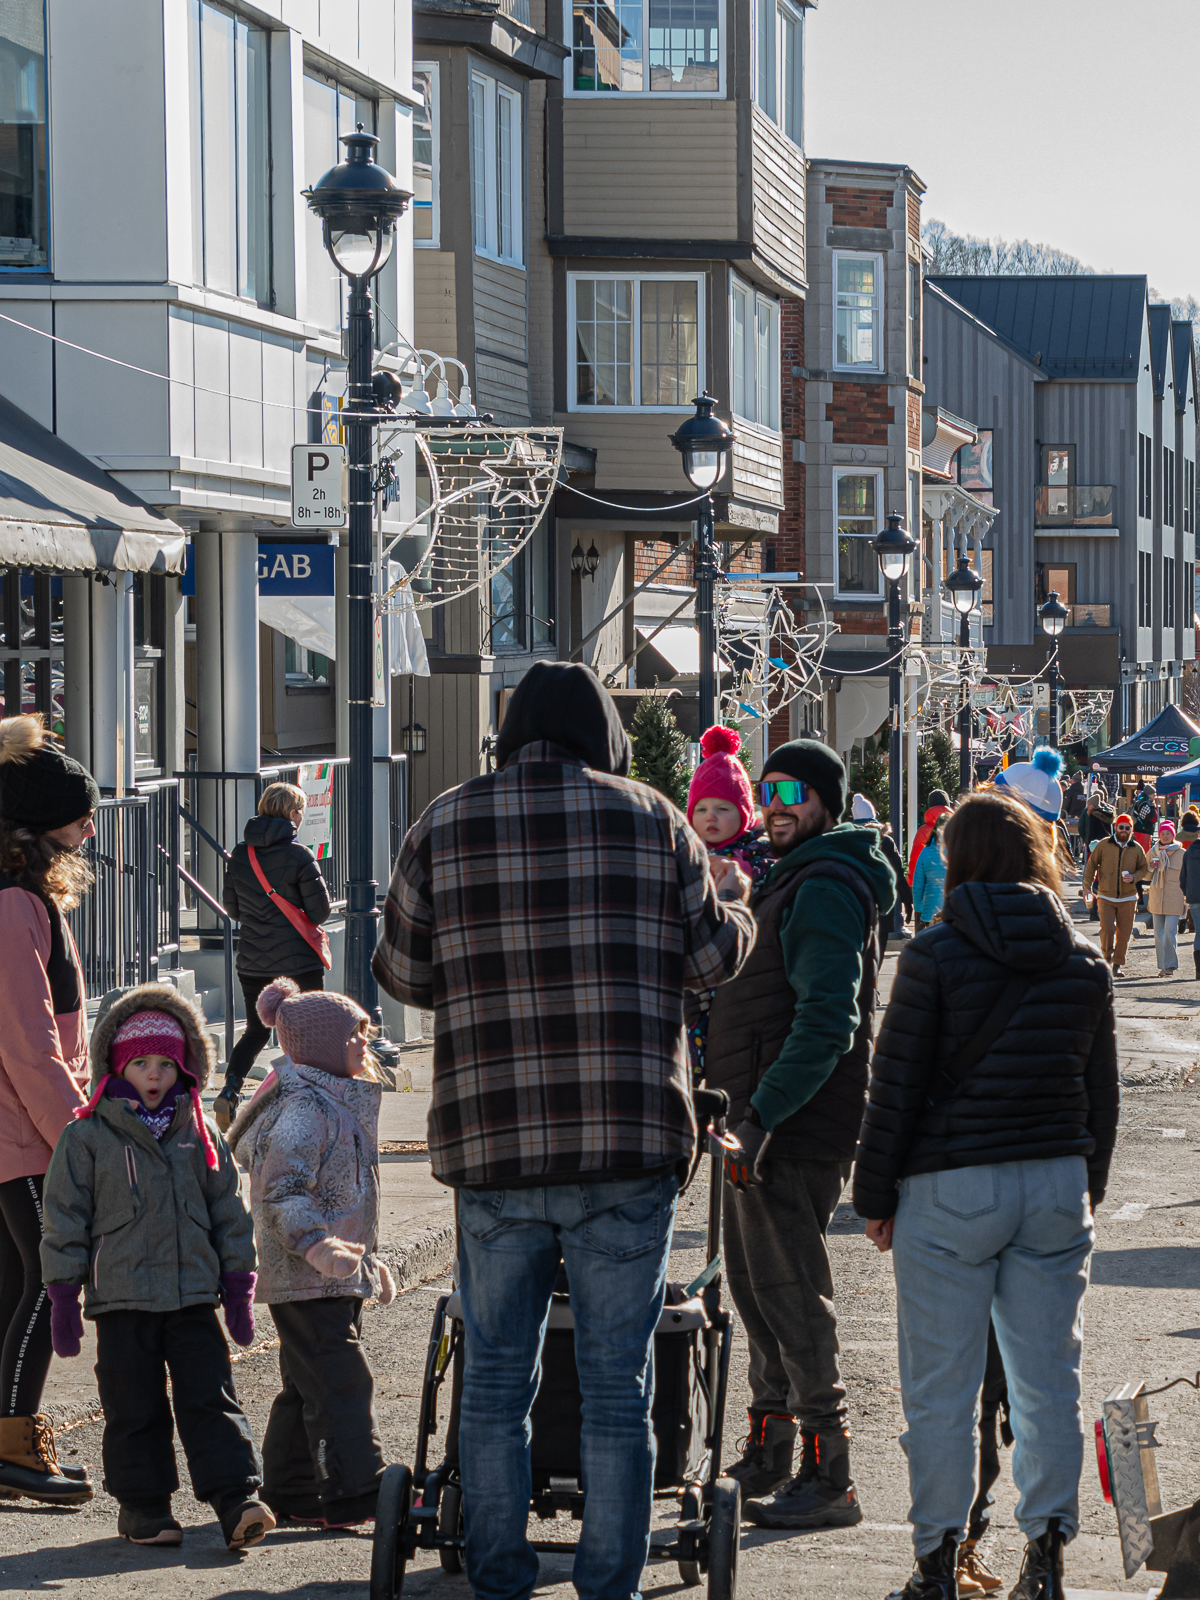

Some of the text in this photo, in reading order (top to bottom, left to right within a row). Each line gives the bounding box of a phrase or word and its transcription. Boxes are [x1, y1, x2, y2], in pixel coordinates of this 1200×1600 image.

[307, 452, 330, 482] P
[312, 488, 326, 500] 2h
[297, 506, 311, 519] 8h
[323, 506, 341, 519] 18h
[1037, 685, 1045, 695] P
